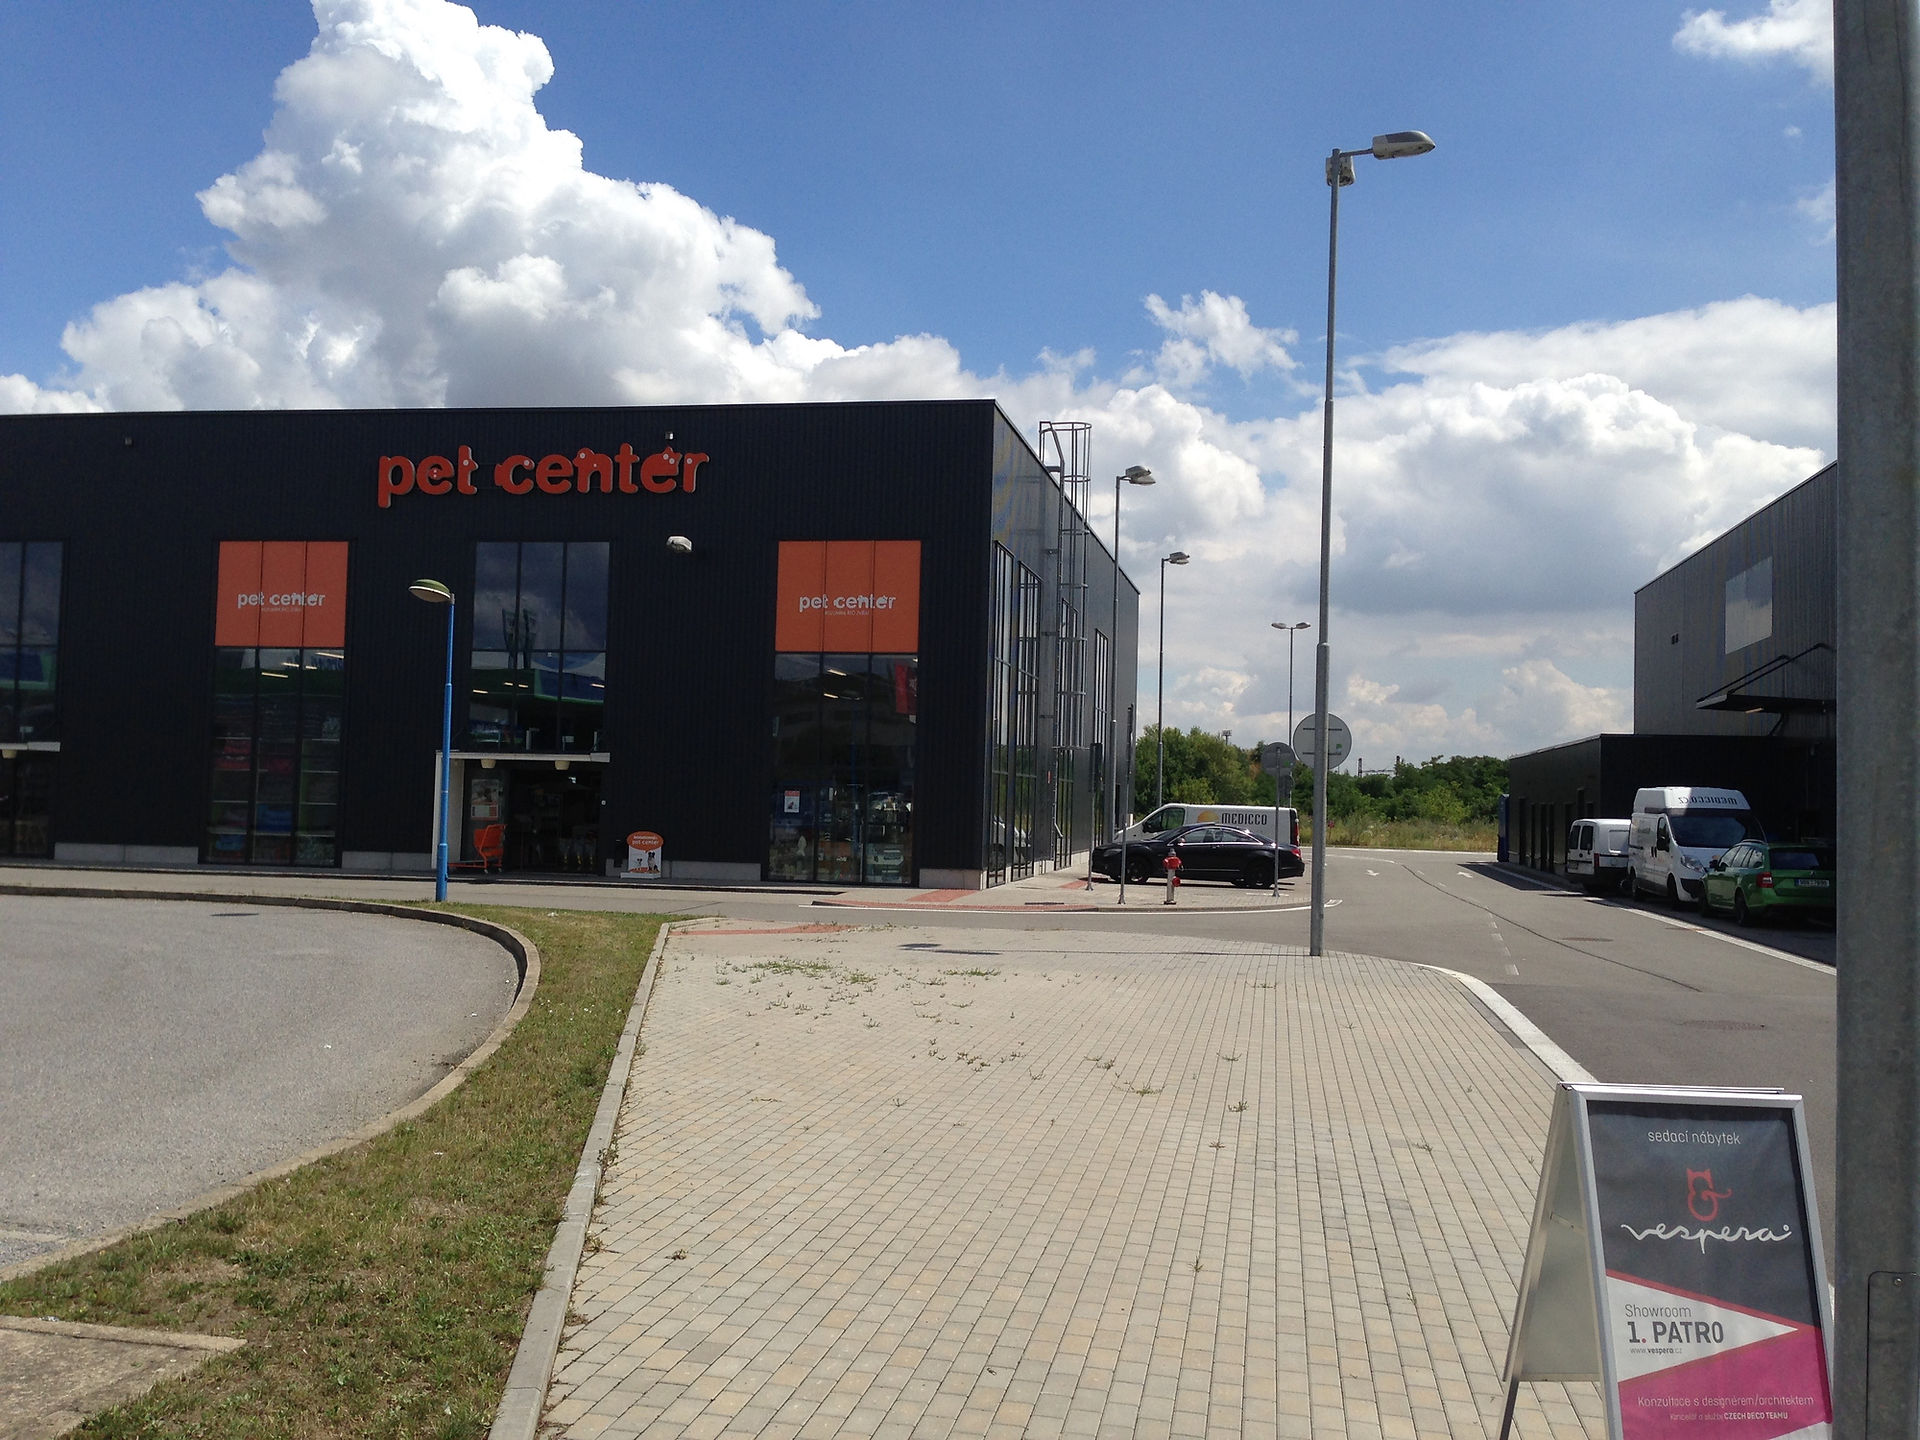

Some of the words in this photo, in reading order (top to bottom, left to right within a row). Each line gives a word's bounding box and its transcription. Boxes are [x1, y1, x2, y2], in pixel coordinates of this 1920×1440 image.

[378, 445, 478, 508] pet
[495, 443, 709, 494] center
[237, 591, 265, 608] pet
[269, 591, 326, 606] center
[799, 594, 828, 612] pet
[833, 593, 896, 609] center
[1221, 812, 1268, 825] MEDICCO
[1647, 1130, 1689, 1143] sedací
[1692, 1131, 1741, 1146] nábytek
[1620, 1222, 1793, 1255] vespera
[1624, 1304, 1692, 1318] Showroom
[1627, 1321, 1646, 1343] 1.
[1652, 1321, 1724, 1343] PATRO
[1630, 1347, 1683, 1355] www.vespera.cz
[1637, 1396, 1691, 1408] Konzultace
[1724, 1412, 1746, 1420] CZECH
[1766, 1411, 1789, 1420] TEAMU
